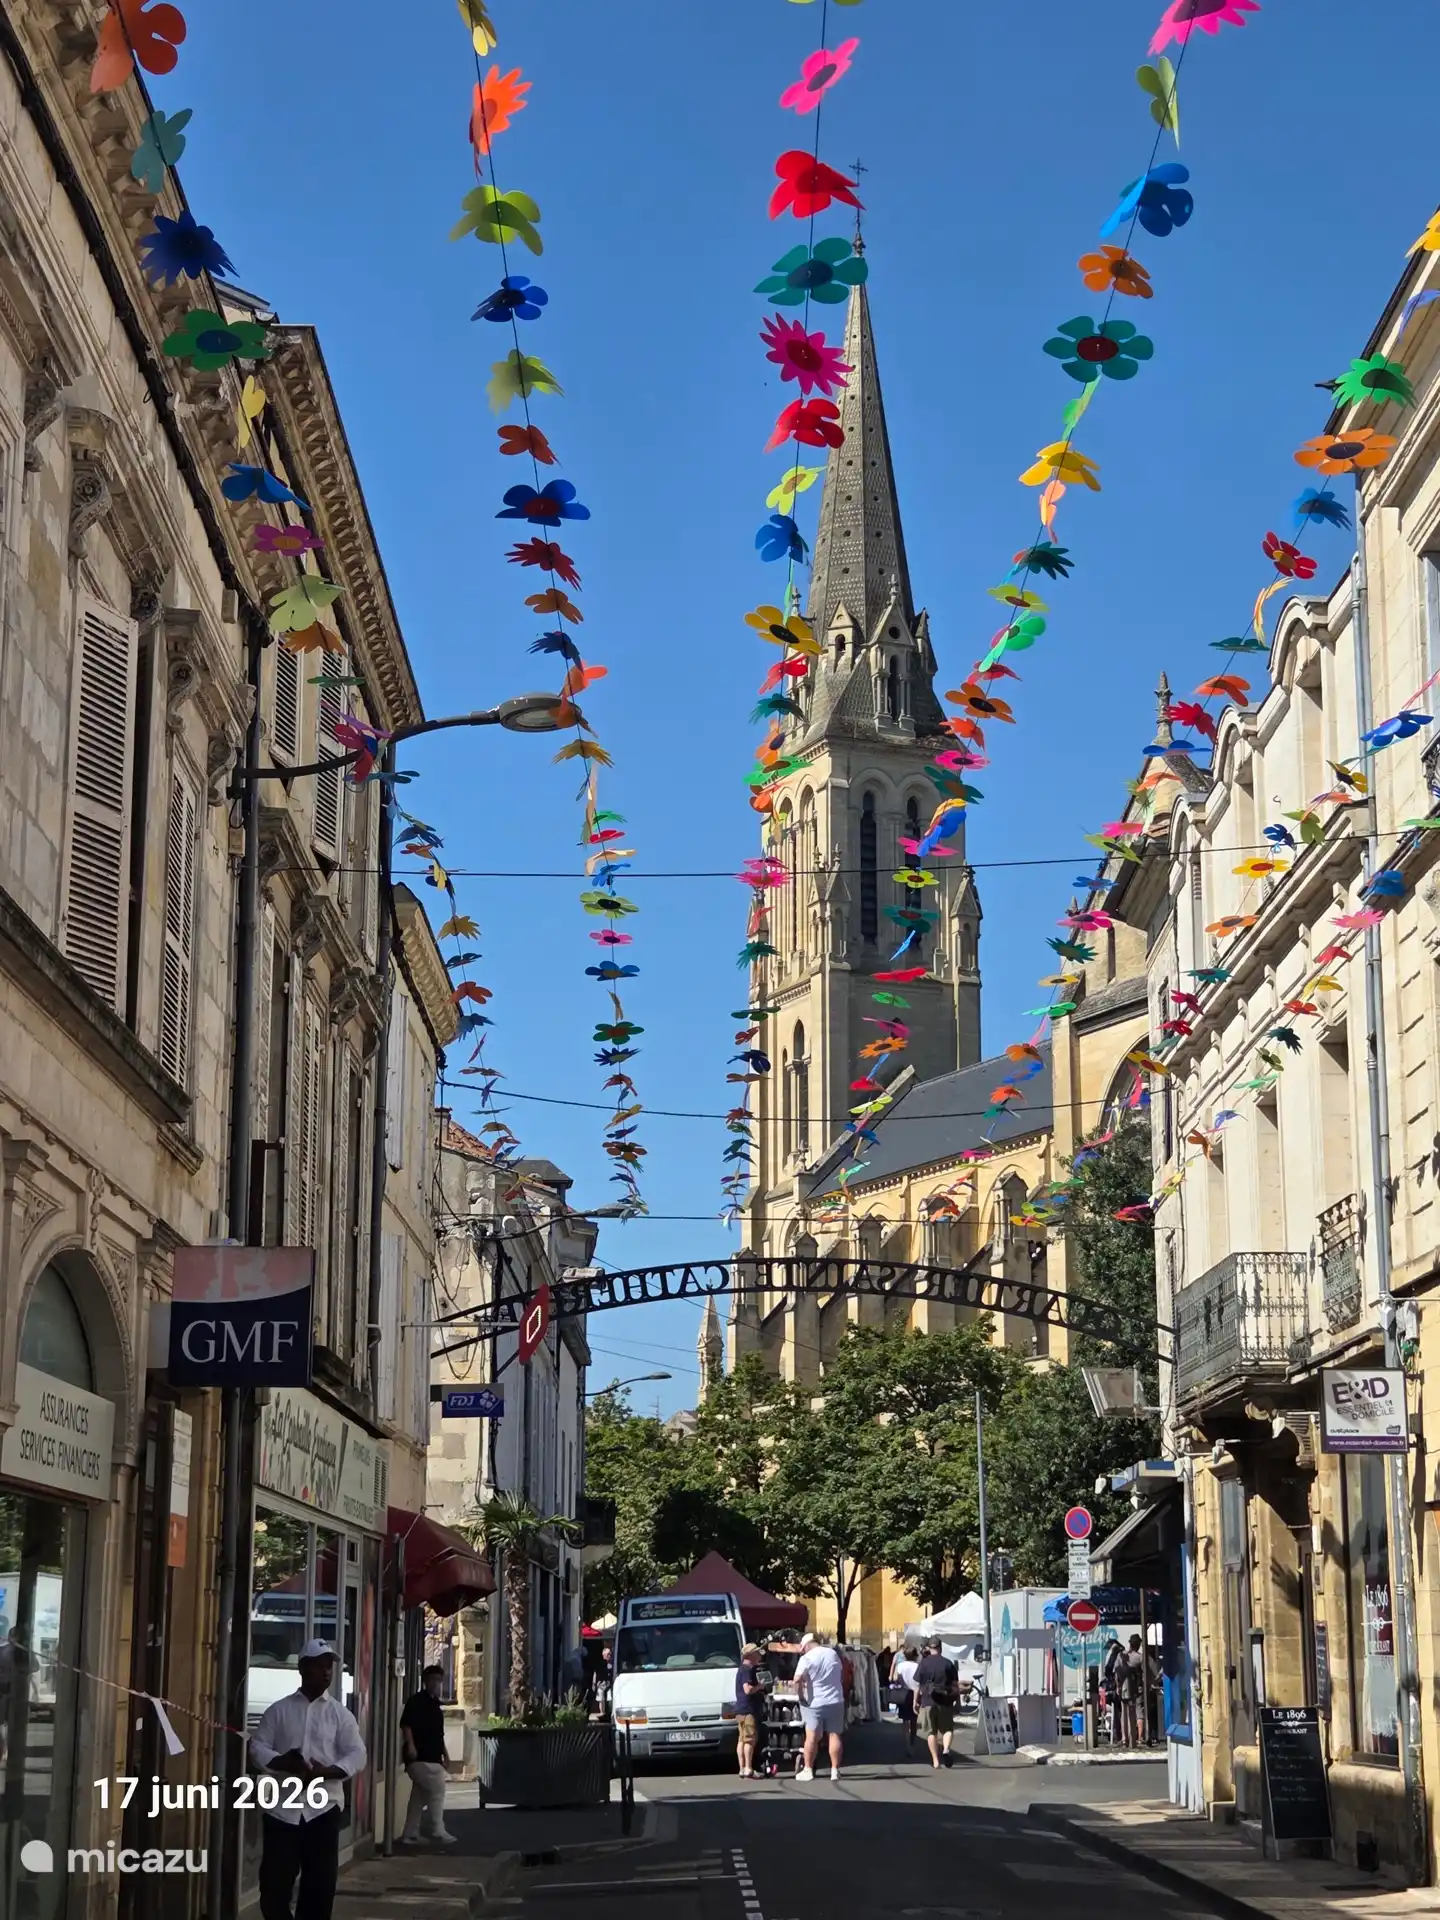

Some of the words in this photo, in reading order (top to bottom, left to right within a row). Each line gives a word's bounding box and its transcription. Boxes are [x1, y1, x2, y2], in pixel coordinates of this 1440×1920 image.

[182, 1320, 298, 1363] GMF
[449, 1395, 475, 1407] FDJ
[1337, 1401, 1384, 1414] ESSENTIEL
[39, 1391, 90, 1436] ASSURANCES
[1352, 1407, 1395, 1420] DOMICILE
[20, 1428, 56, 1467] SERVICES
[57, 1441, 101, 1481] FINANCIERS
[1375, 1583, 1388, 1612] 1896
[1286, 1709, 1307, 1720] 1896
